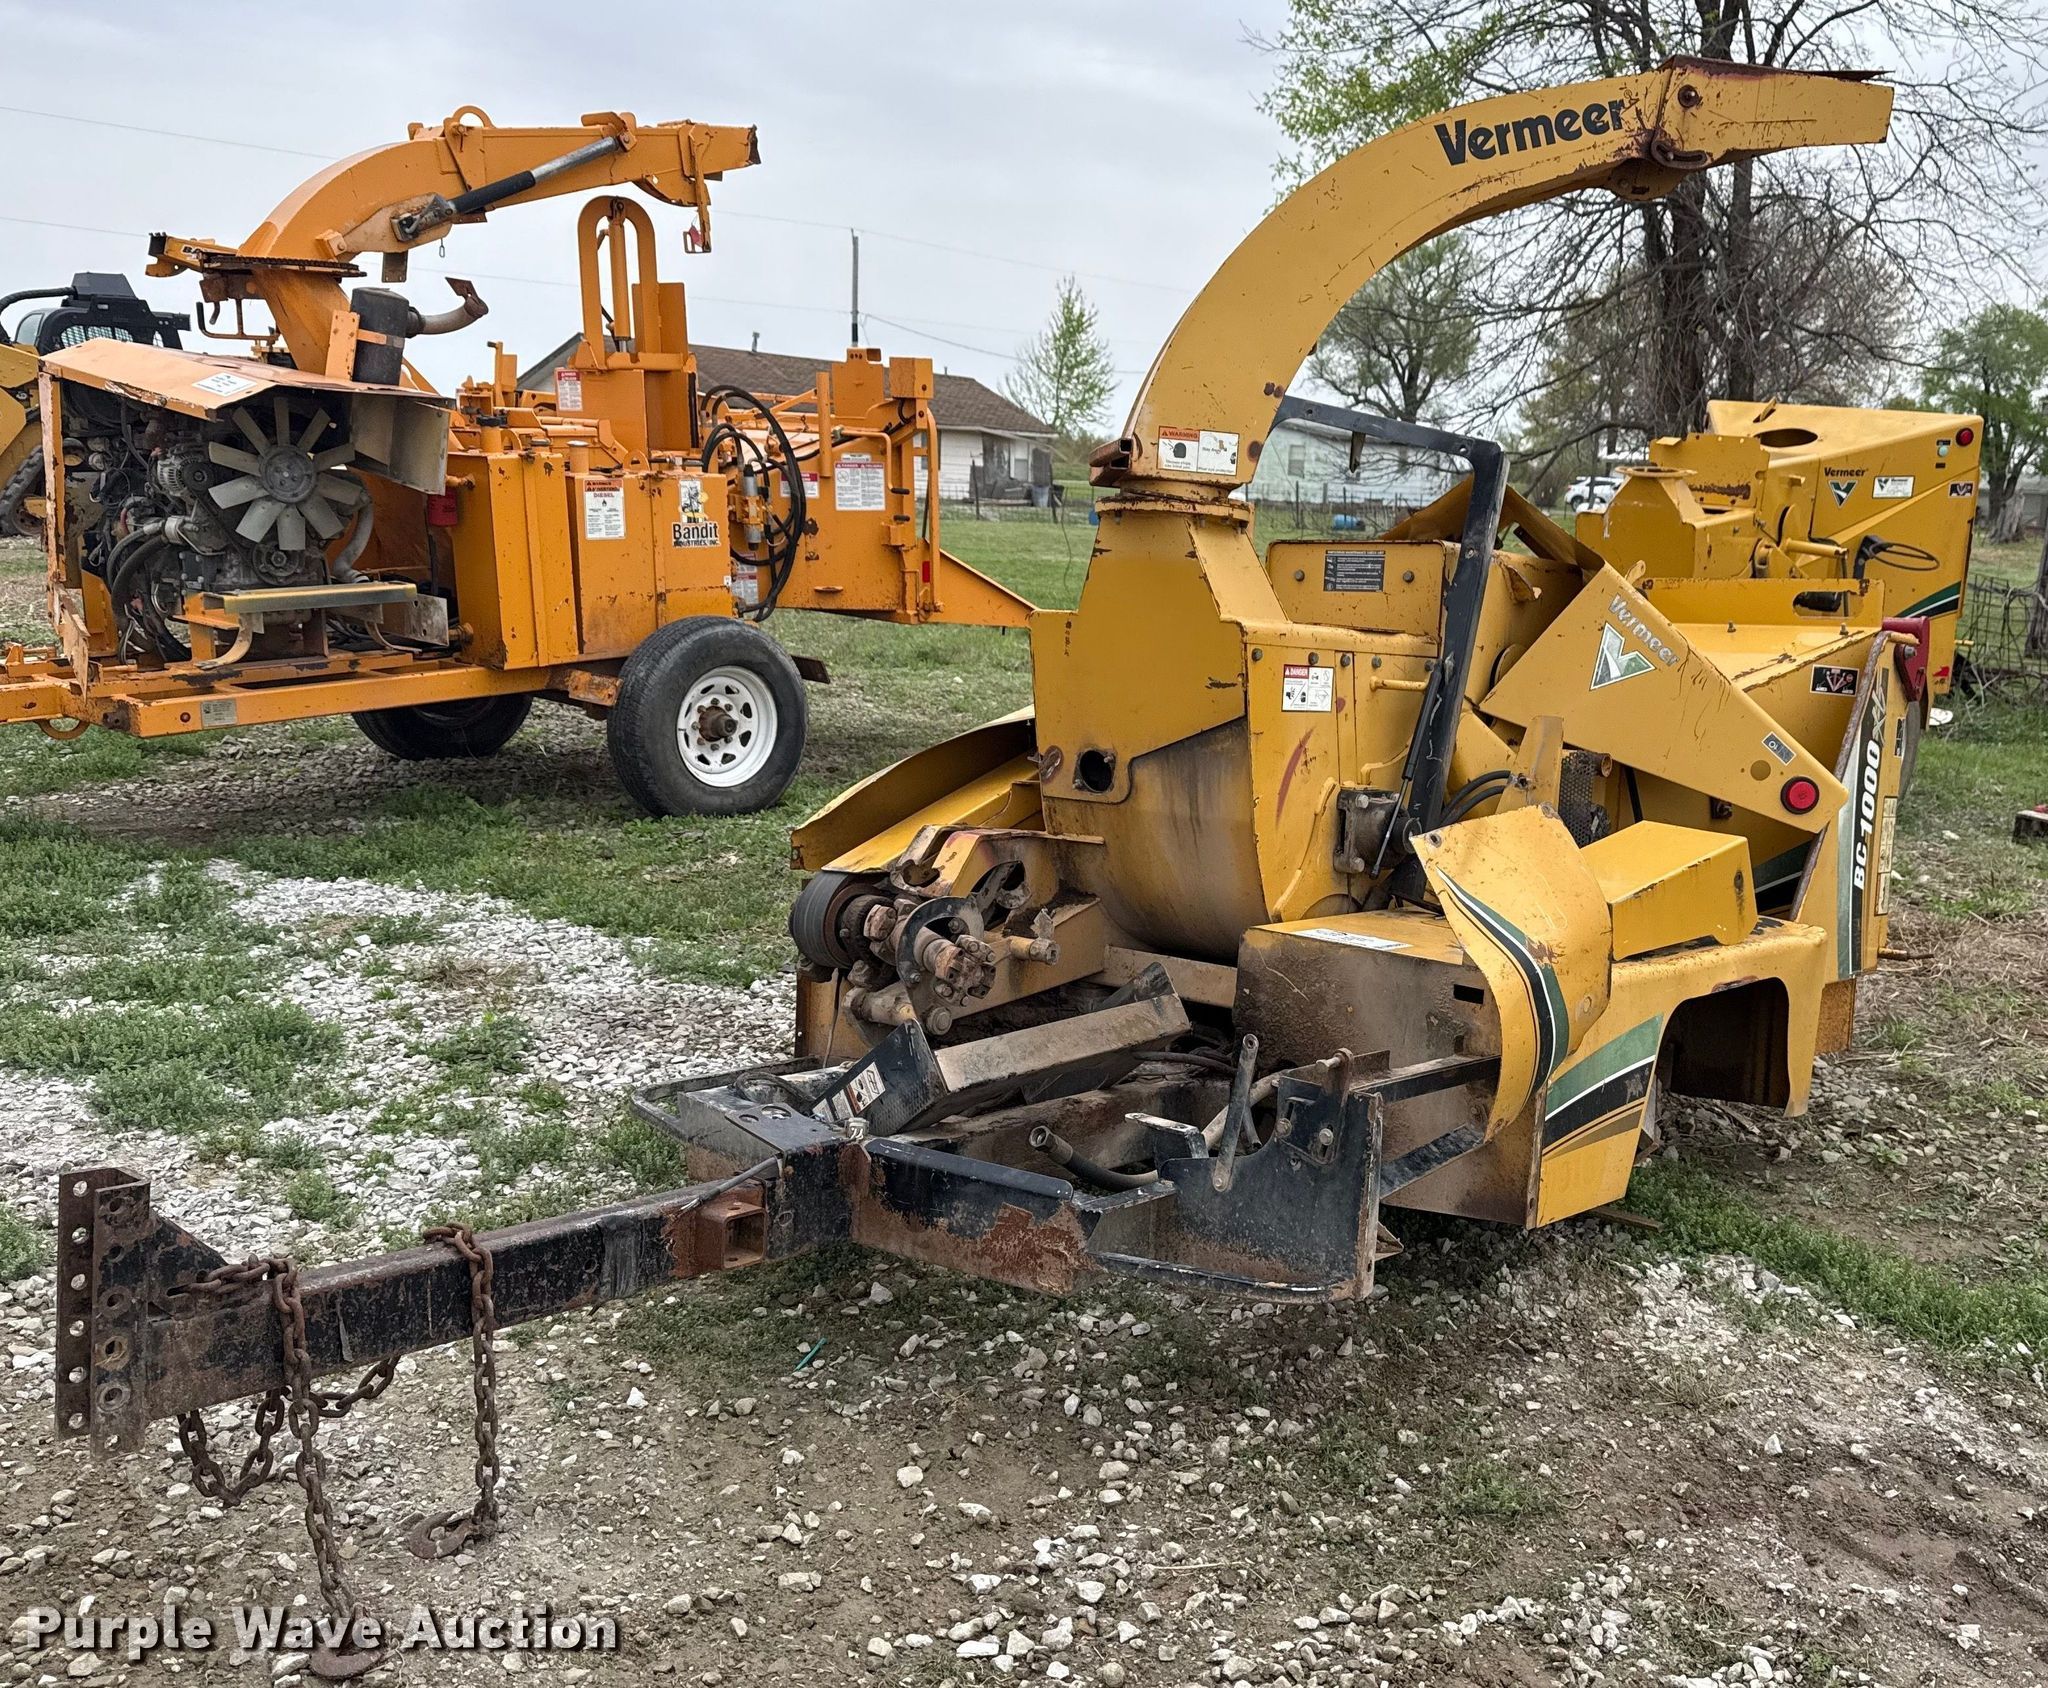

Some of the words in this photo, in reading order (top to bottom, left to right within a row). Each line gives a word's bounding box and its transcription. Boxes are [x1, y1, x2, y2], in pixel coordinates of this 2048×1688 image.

[1434, 98, 1626, 166] Vermeer
[1824, 467, 1866, 477] Vermeer
[672, 523, 719, 540] Bandit
[1608, 592, 1680, 667] Vermeer
